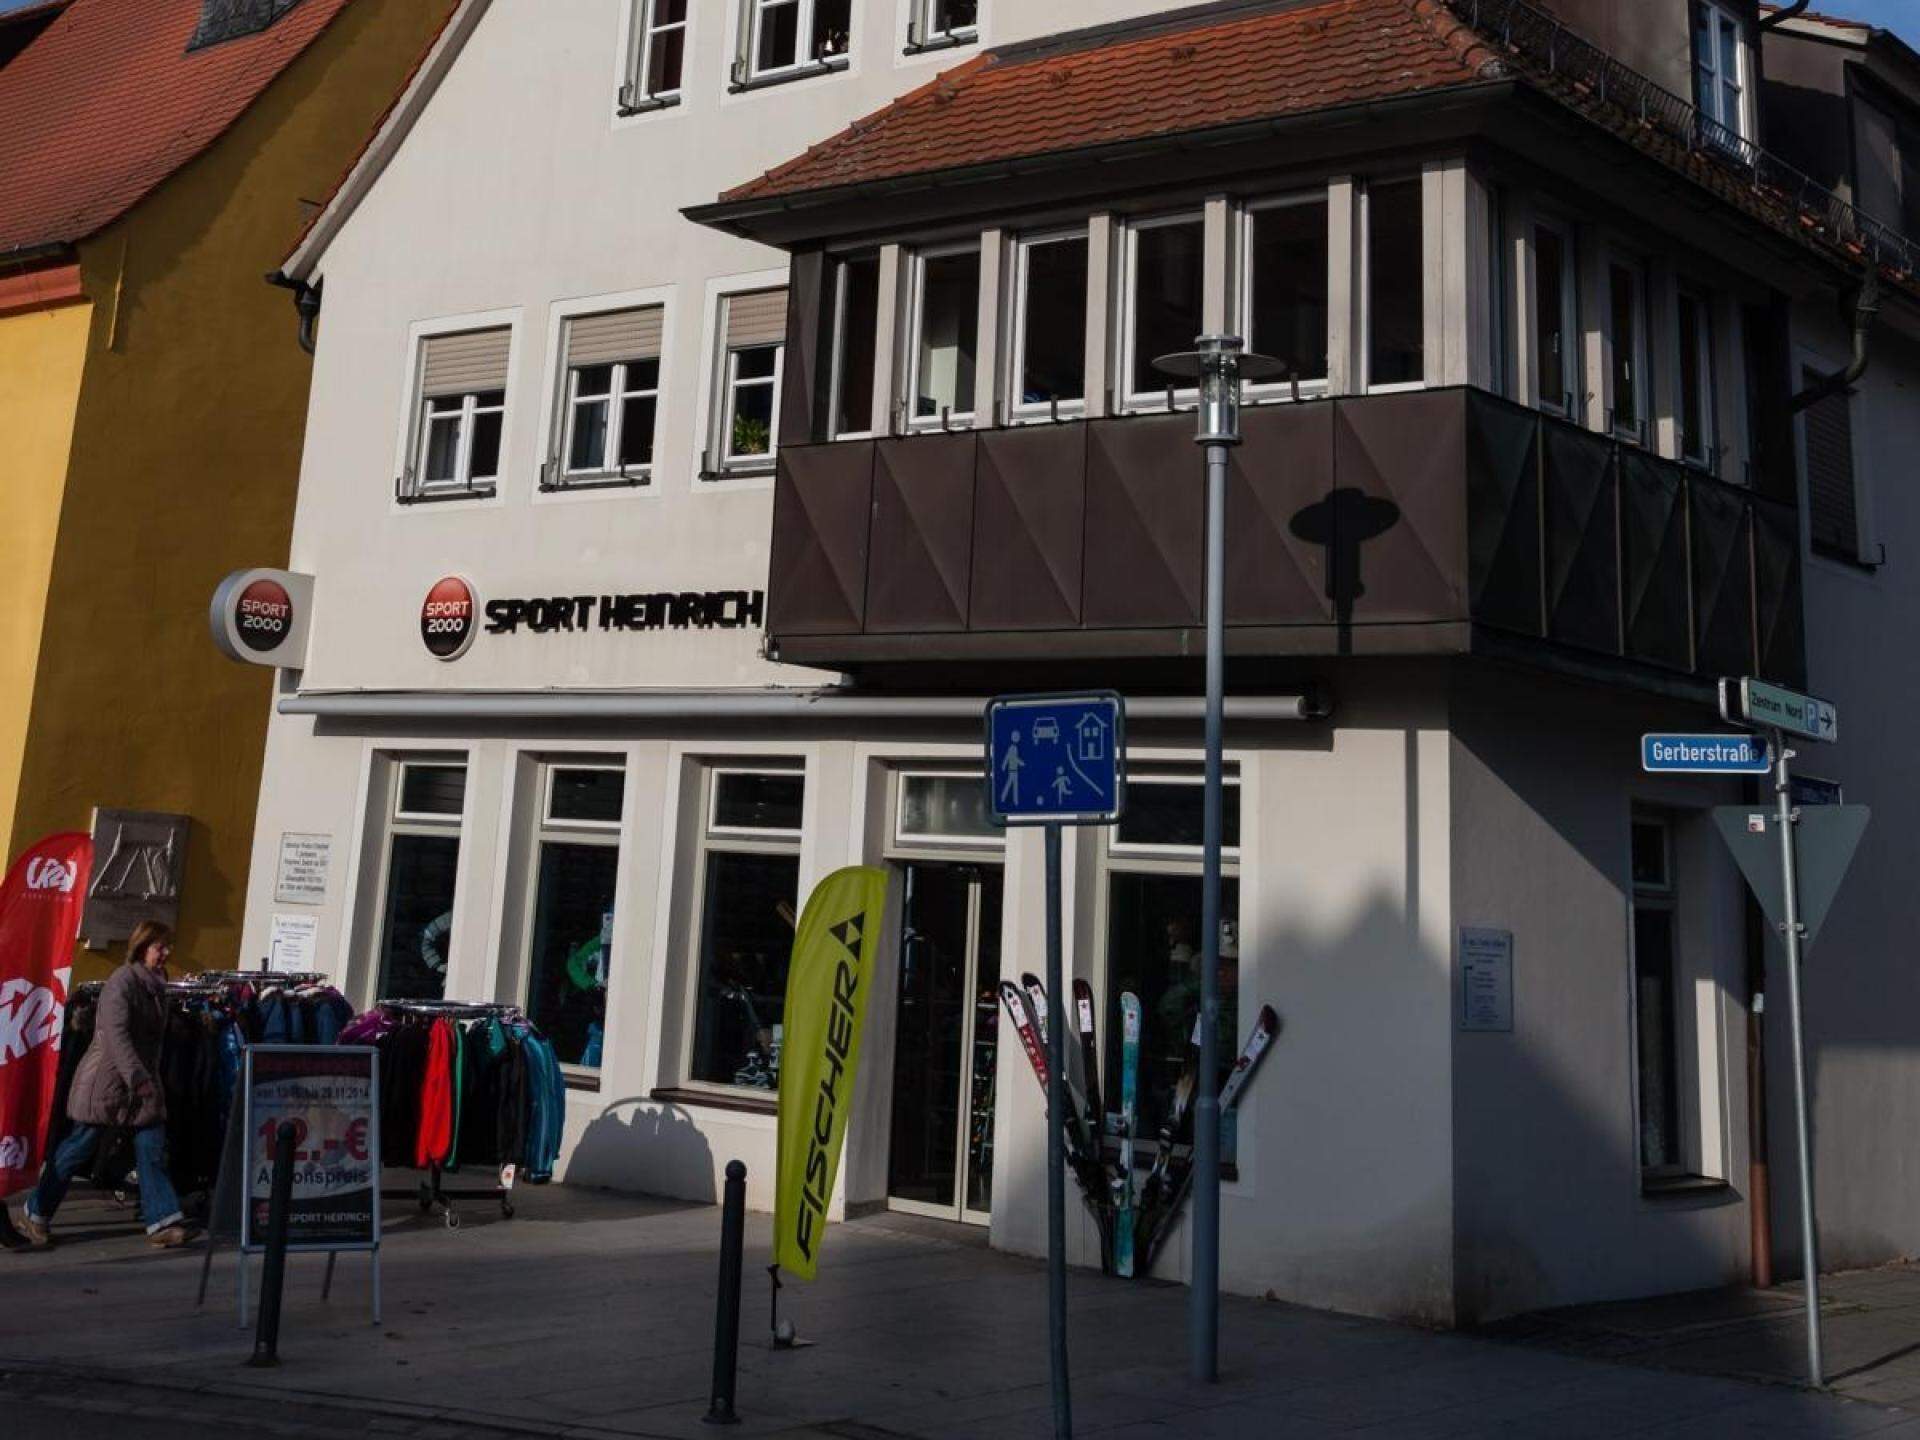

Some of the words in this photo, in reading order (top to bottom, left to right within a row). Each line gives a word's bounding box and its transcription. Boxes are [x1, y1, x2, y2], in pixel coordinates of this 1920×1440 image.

[241, 600, 288, 617] SPORT
[426, 601, 469, 617] SPORT
[485, 596, 597, 634] SPORT
[598, 590, 764, 632] HEINRICH
[243, 617, 282, 632] 2000
[427, 618, 463, 633] 2000
[1785, 700, 1804, 721] Nord
[1652, 741, 1763, 763] Gerberstraße
[797, 959, 858, 1262] FISCHER
[257, 1166, 367, 1187] Aonspreis
